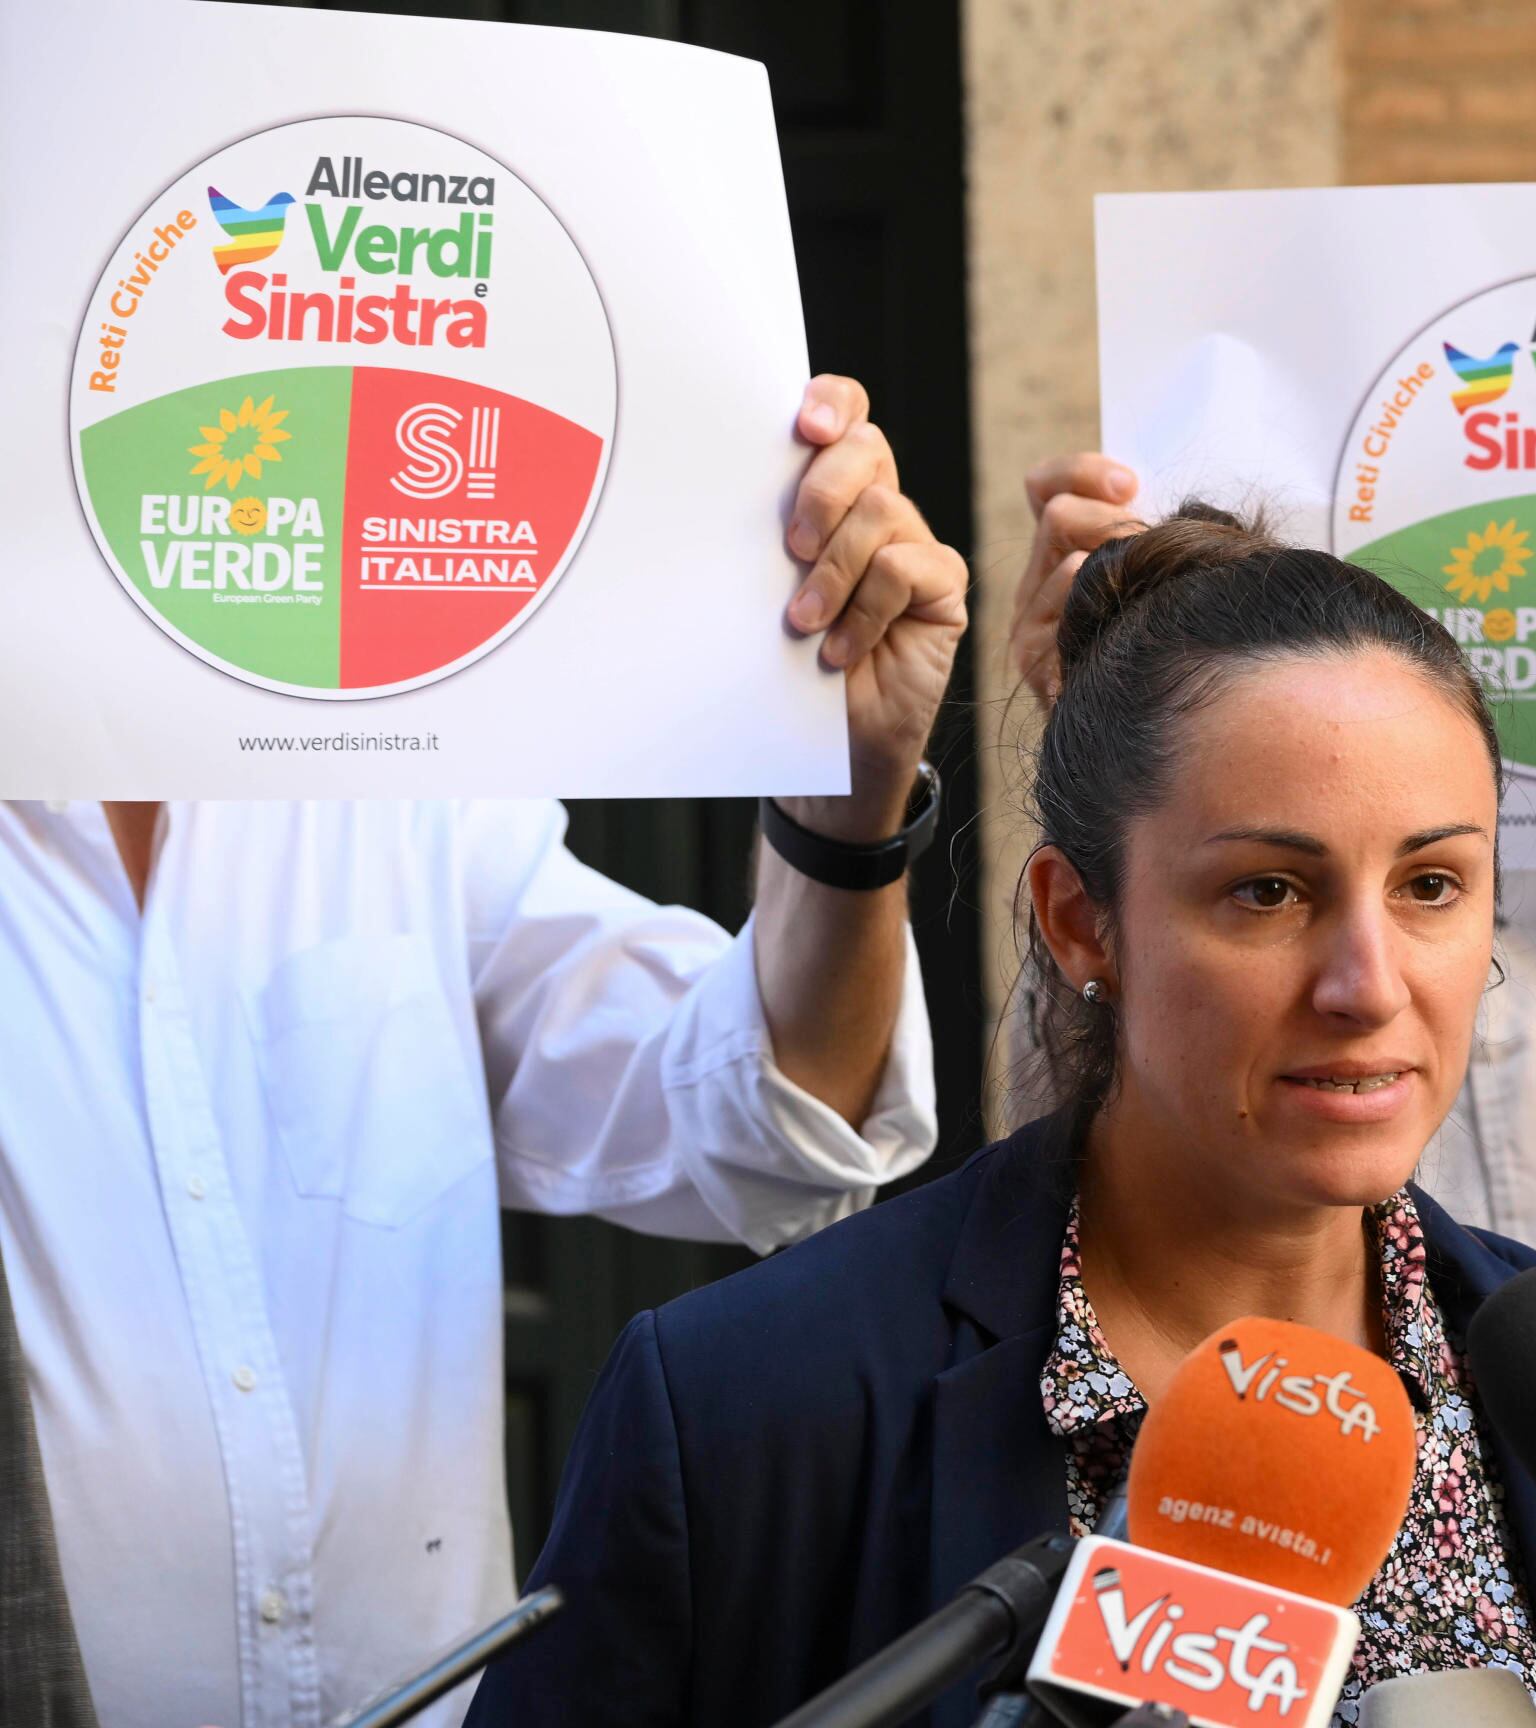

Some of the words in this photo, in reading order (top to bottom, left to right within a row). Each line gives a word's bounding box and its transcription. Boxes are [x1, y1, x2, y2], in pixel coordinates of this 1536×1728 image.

[304, 156, 495, 206] Alleanza
[304, 204, 494, 279] Verdi
[89, 322, 128, 393] Reti
[110, 209, 198, 319] Civiche
[221, 270, 489, 349] Sinistra
[474, 282, 489, 298] e
[1349, 464, 1379, 524] Reti
[1364, 361, 1435, 457] Civiche
[140, 494, 324, 538] EUROPA
[361, 517, 538, 544] SINISTRA
[140, 540, 324, 592] VERDE
[361, 556, 537, 583] ITALIANA
[212, 592, 261, 605] European
[263, 593, 294, 604] Green
[295, 594, 322, 606] Party
[238, 732, 440, 752] www.verdisinistra.it
